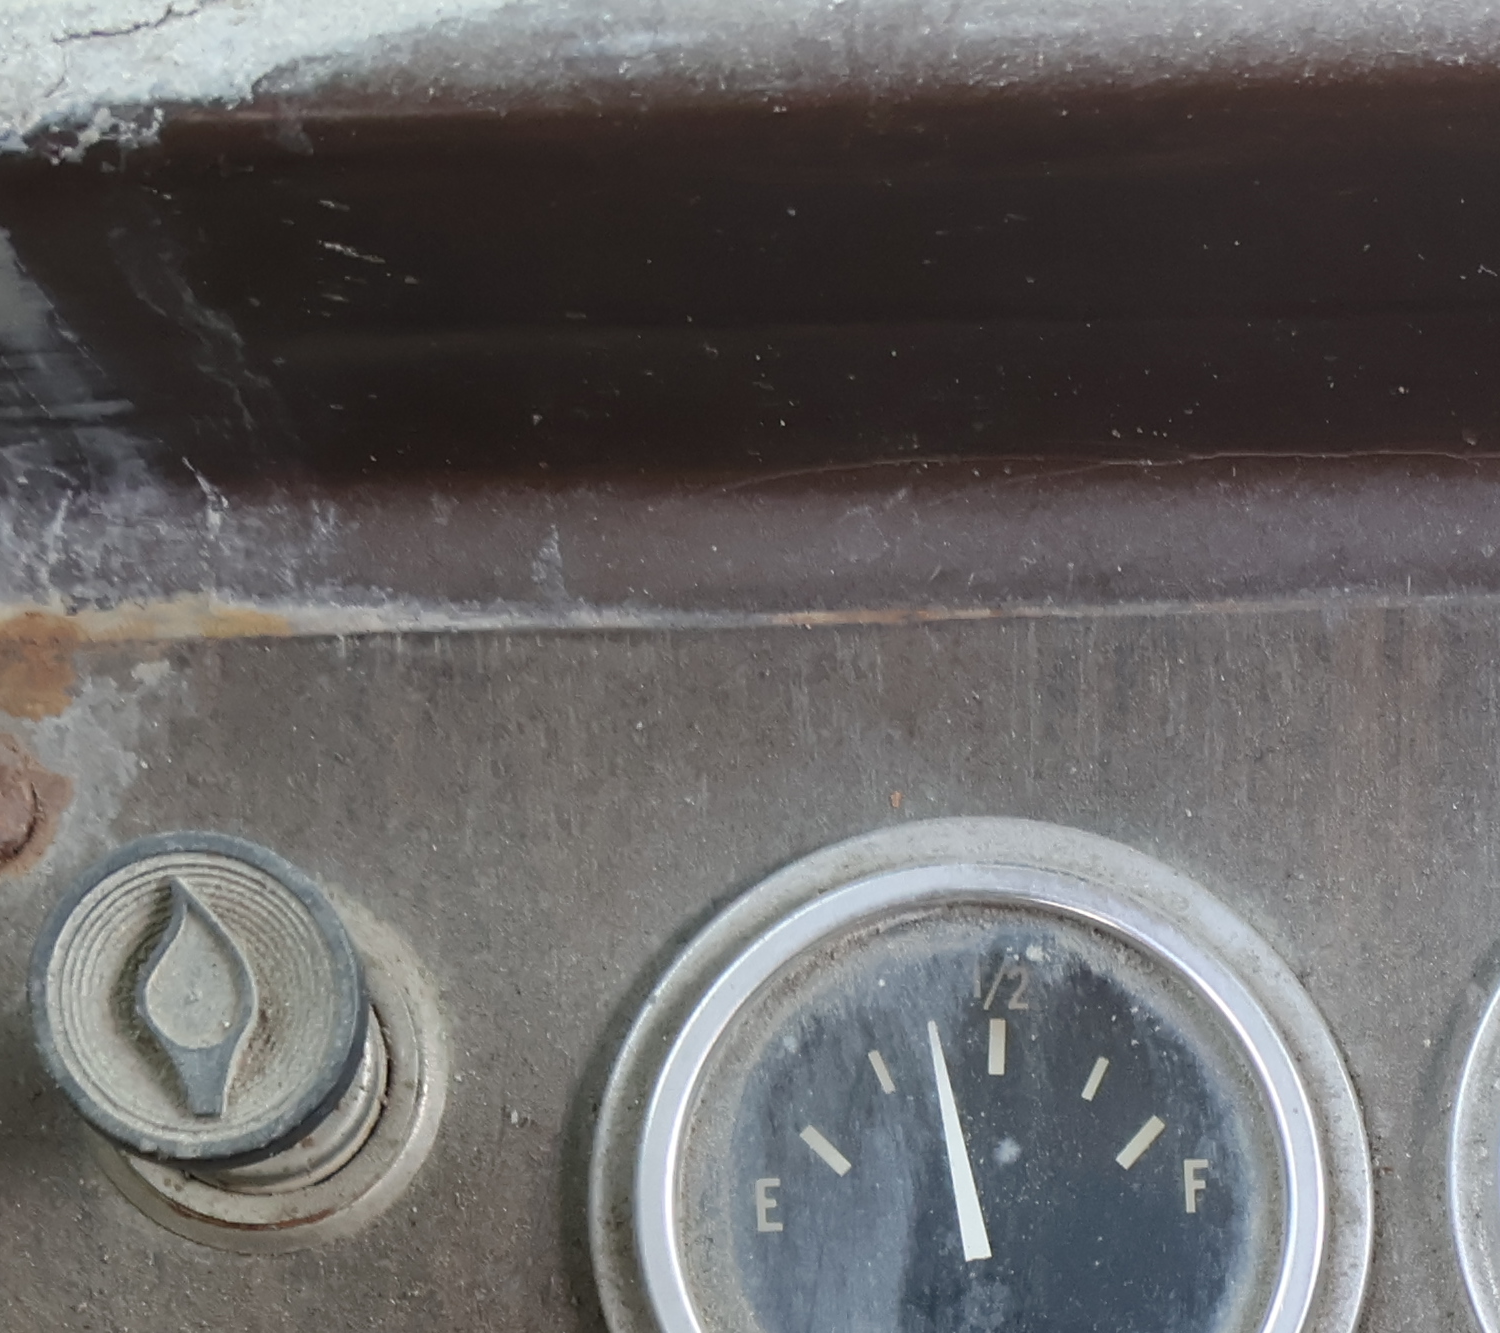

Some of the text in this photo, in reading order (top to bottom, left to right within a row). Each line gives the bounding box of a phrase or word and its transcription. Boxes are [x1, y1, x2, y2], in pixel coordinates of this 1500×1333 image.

[973, 956, 1030, 1011] 1/2
[754, 1178, 784, 1232] E
[1183, 1158, 1209, 1213] F
